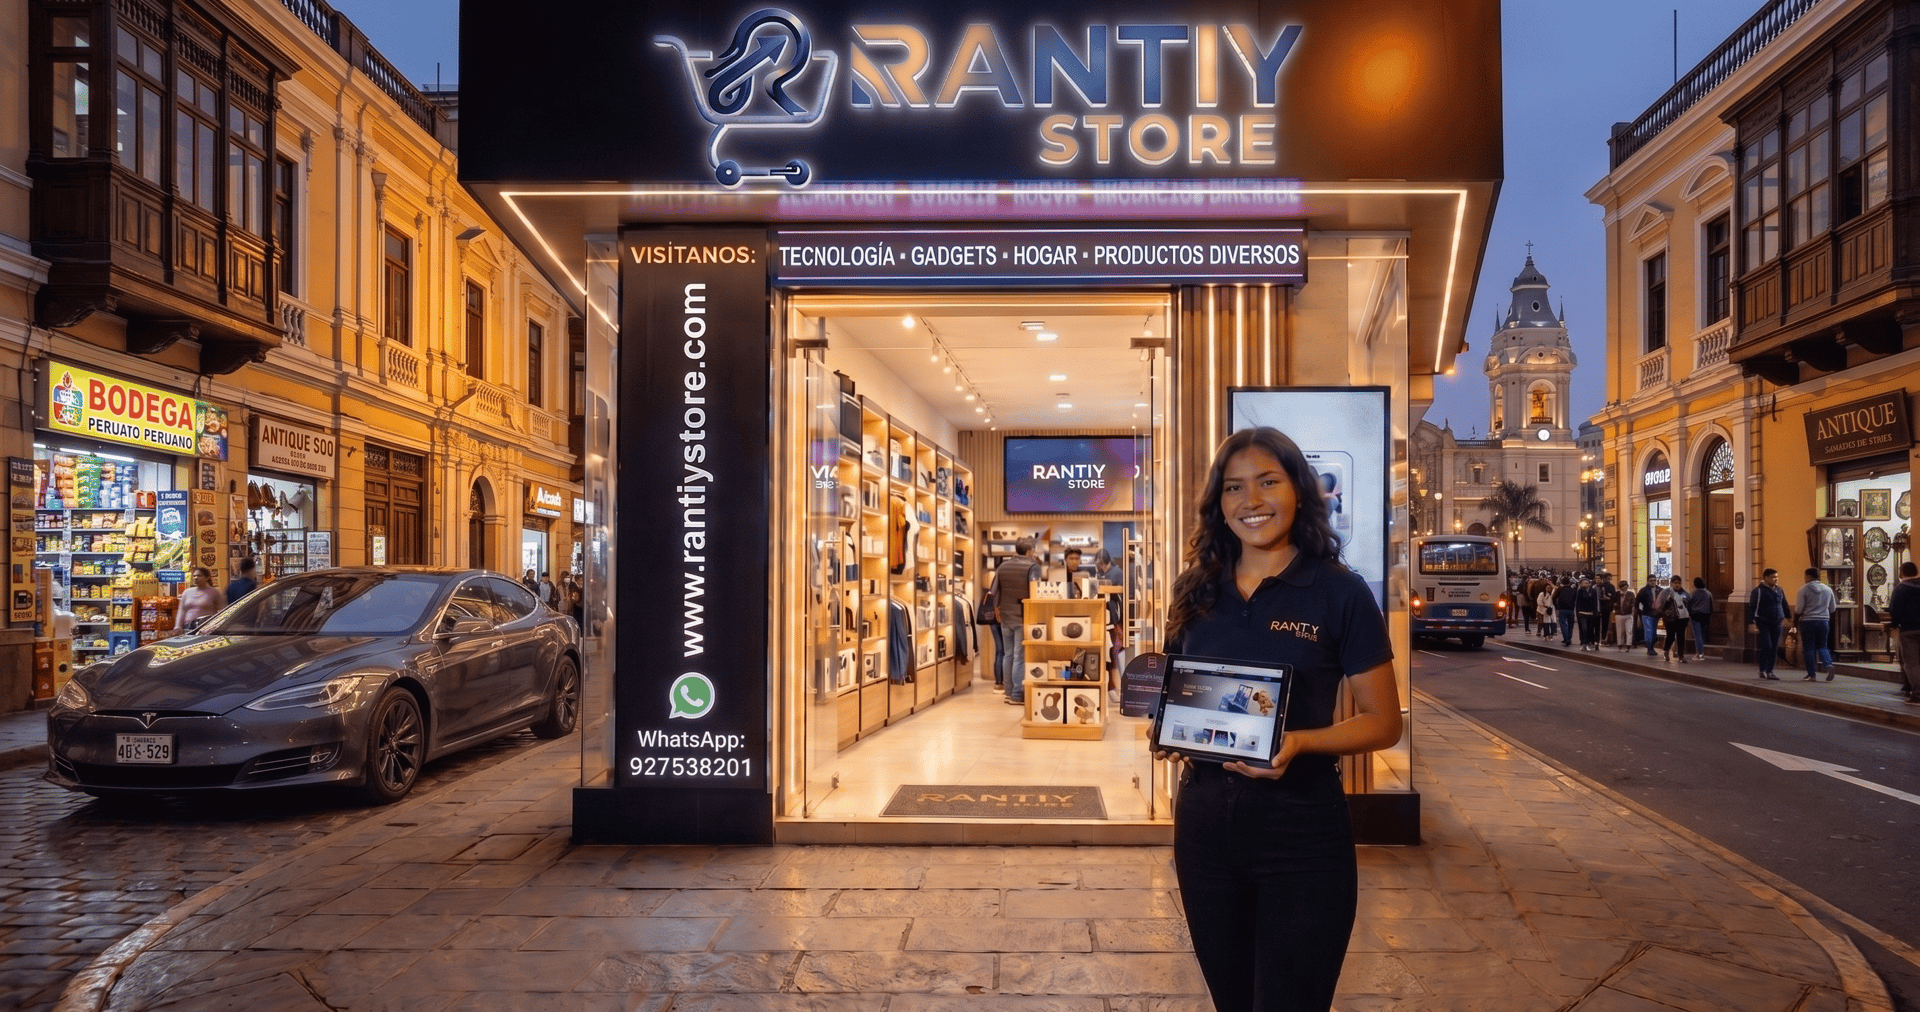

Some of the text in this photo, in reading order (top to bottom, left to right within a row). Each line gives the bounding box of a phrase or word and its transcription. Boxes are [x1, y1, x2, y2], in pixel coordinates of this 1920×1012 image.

[851, 24, 1303, 109] RANTIY
[1039, 114, 1277, 165] STORE
[779, 242, 1300, 267] TECNOLOGÍA GADGETS HOGAR PRODUCTOS DIVERSOS
[89, 378, 193, 431] BODEGA
[88, 417, 193, 450] PERUATO PERUANO
[1816, 401, 1897, 441] ANTIQUE
[261, 424, 311, 452] ANTIQUE
[1857, 438, 1868, 448] DE
[676, 283, 714, 658] www.rantiystore.com
[1033, 464, 1106, 480] RANTIY
[1068, 479, 1105, 489] STORE
[637, 730, 745, 753] WhatsApp:
[630, 757, 751, 777] 927538201
[916, 793, 1076, 802] RANTIY
